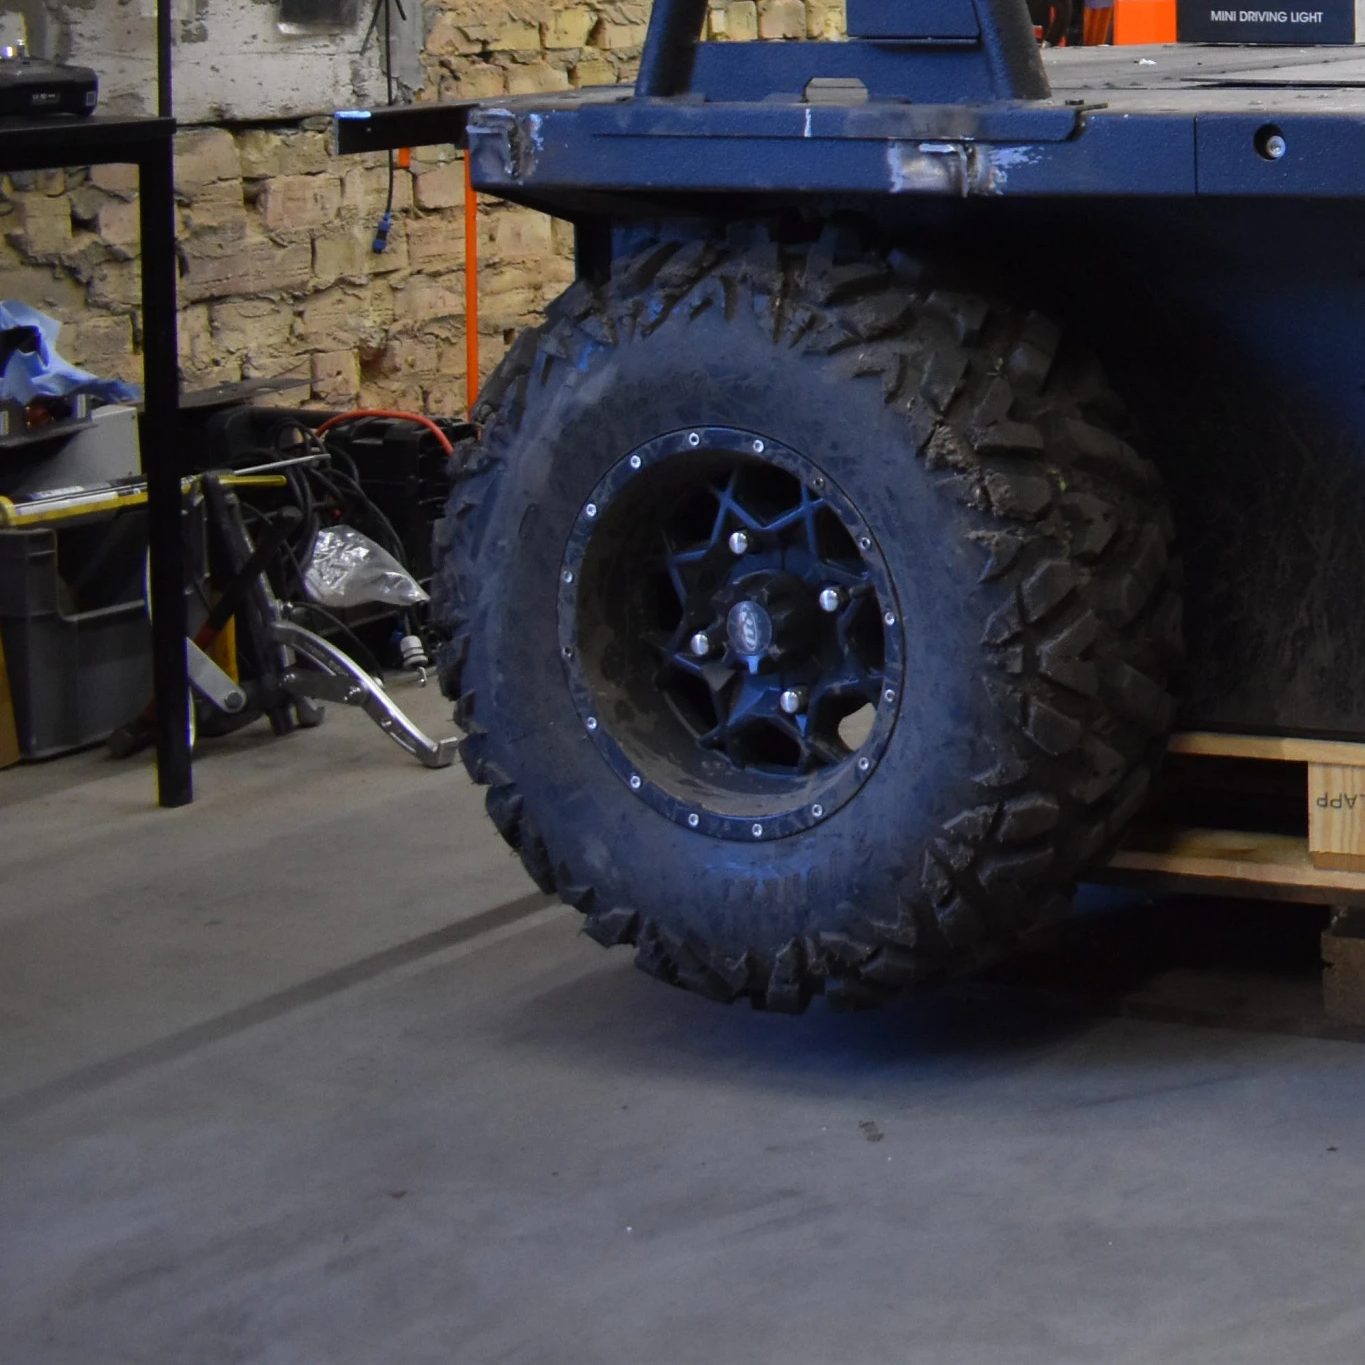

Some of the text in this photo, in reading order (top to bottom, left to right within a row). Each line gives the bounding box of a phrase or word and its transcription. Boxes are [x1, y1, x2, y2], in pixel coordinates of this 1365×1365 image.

[1210, 10, 1324, 23] MINI DRIVING LIGHT
